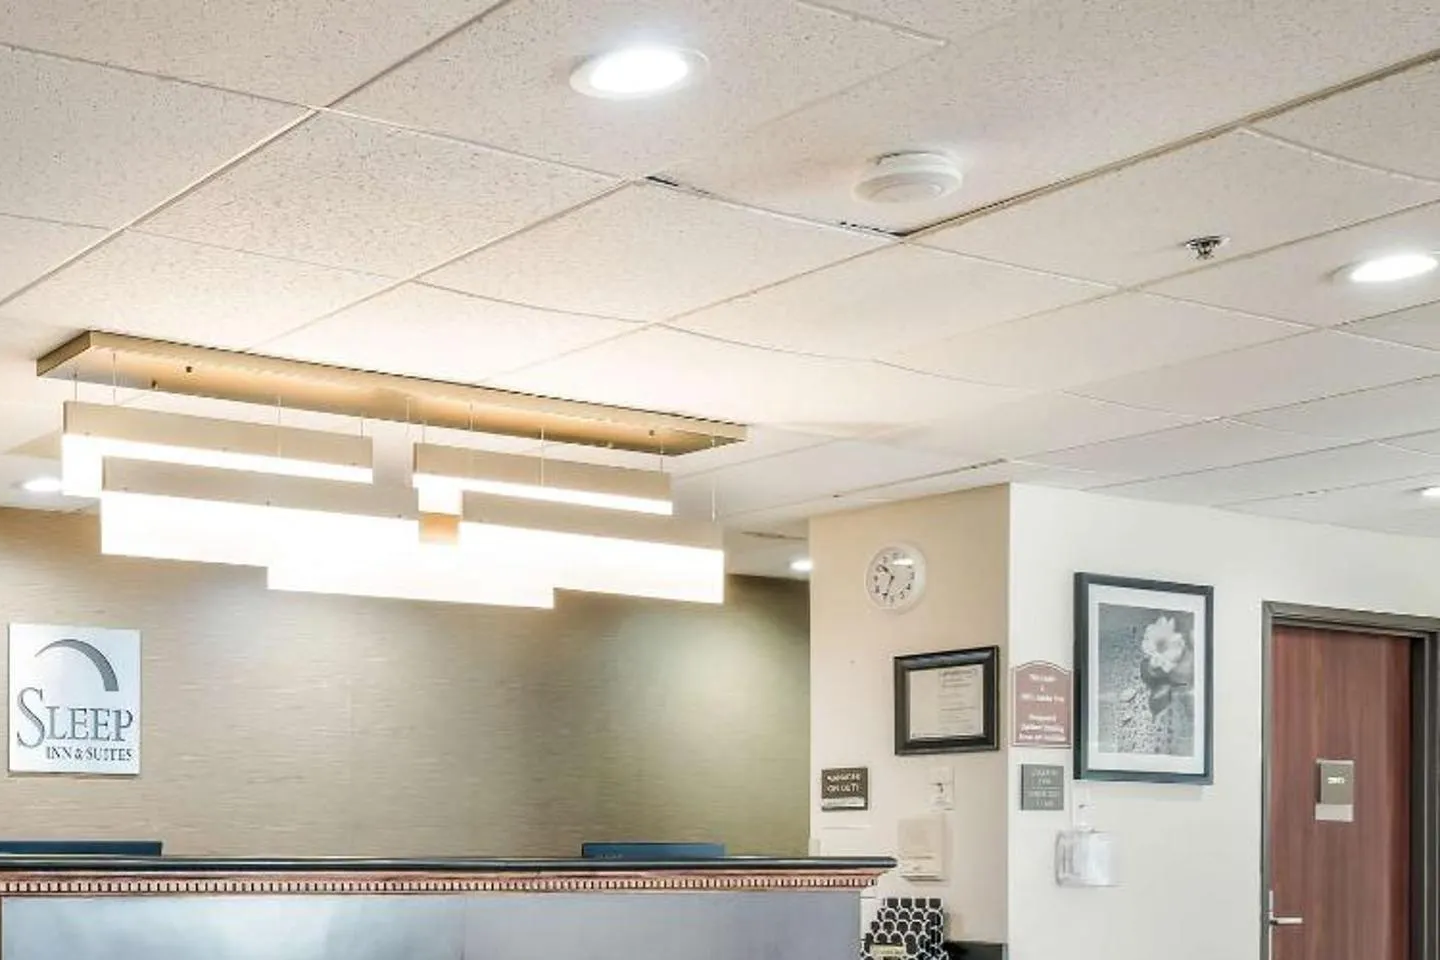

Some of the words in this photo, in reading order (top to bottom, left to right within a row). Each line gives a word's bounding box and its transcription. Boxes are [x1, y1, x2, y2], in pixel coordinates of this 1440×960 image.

[16, 686, 134, 749] SLEEP
[46, 746, 72, 760] INN
[74, 747, 84, 761] &
[85, 746, 133, 762] SUITES
